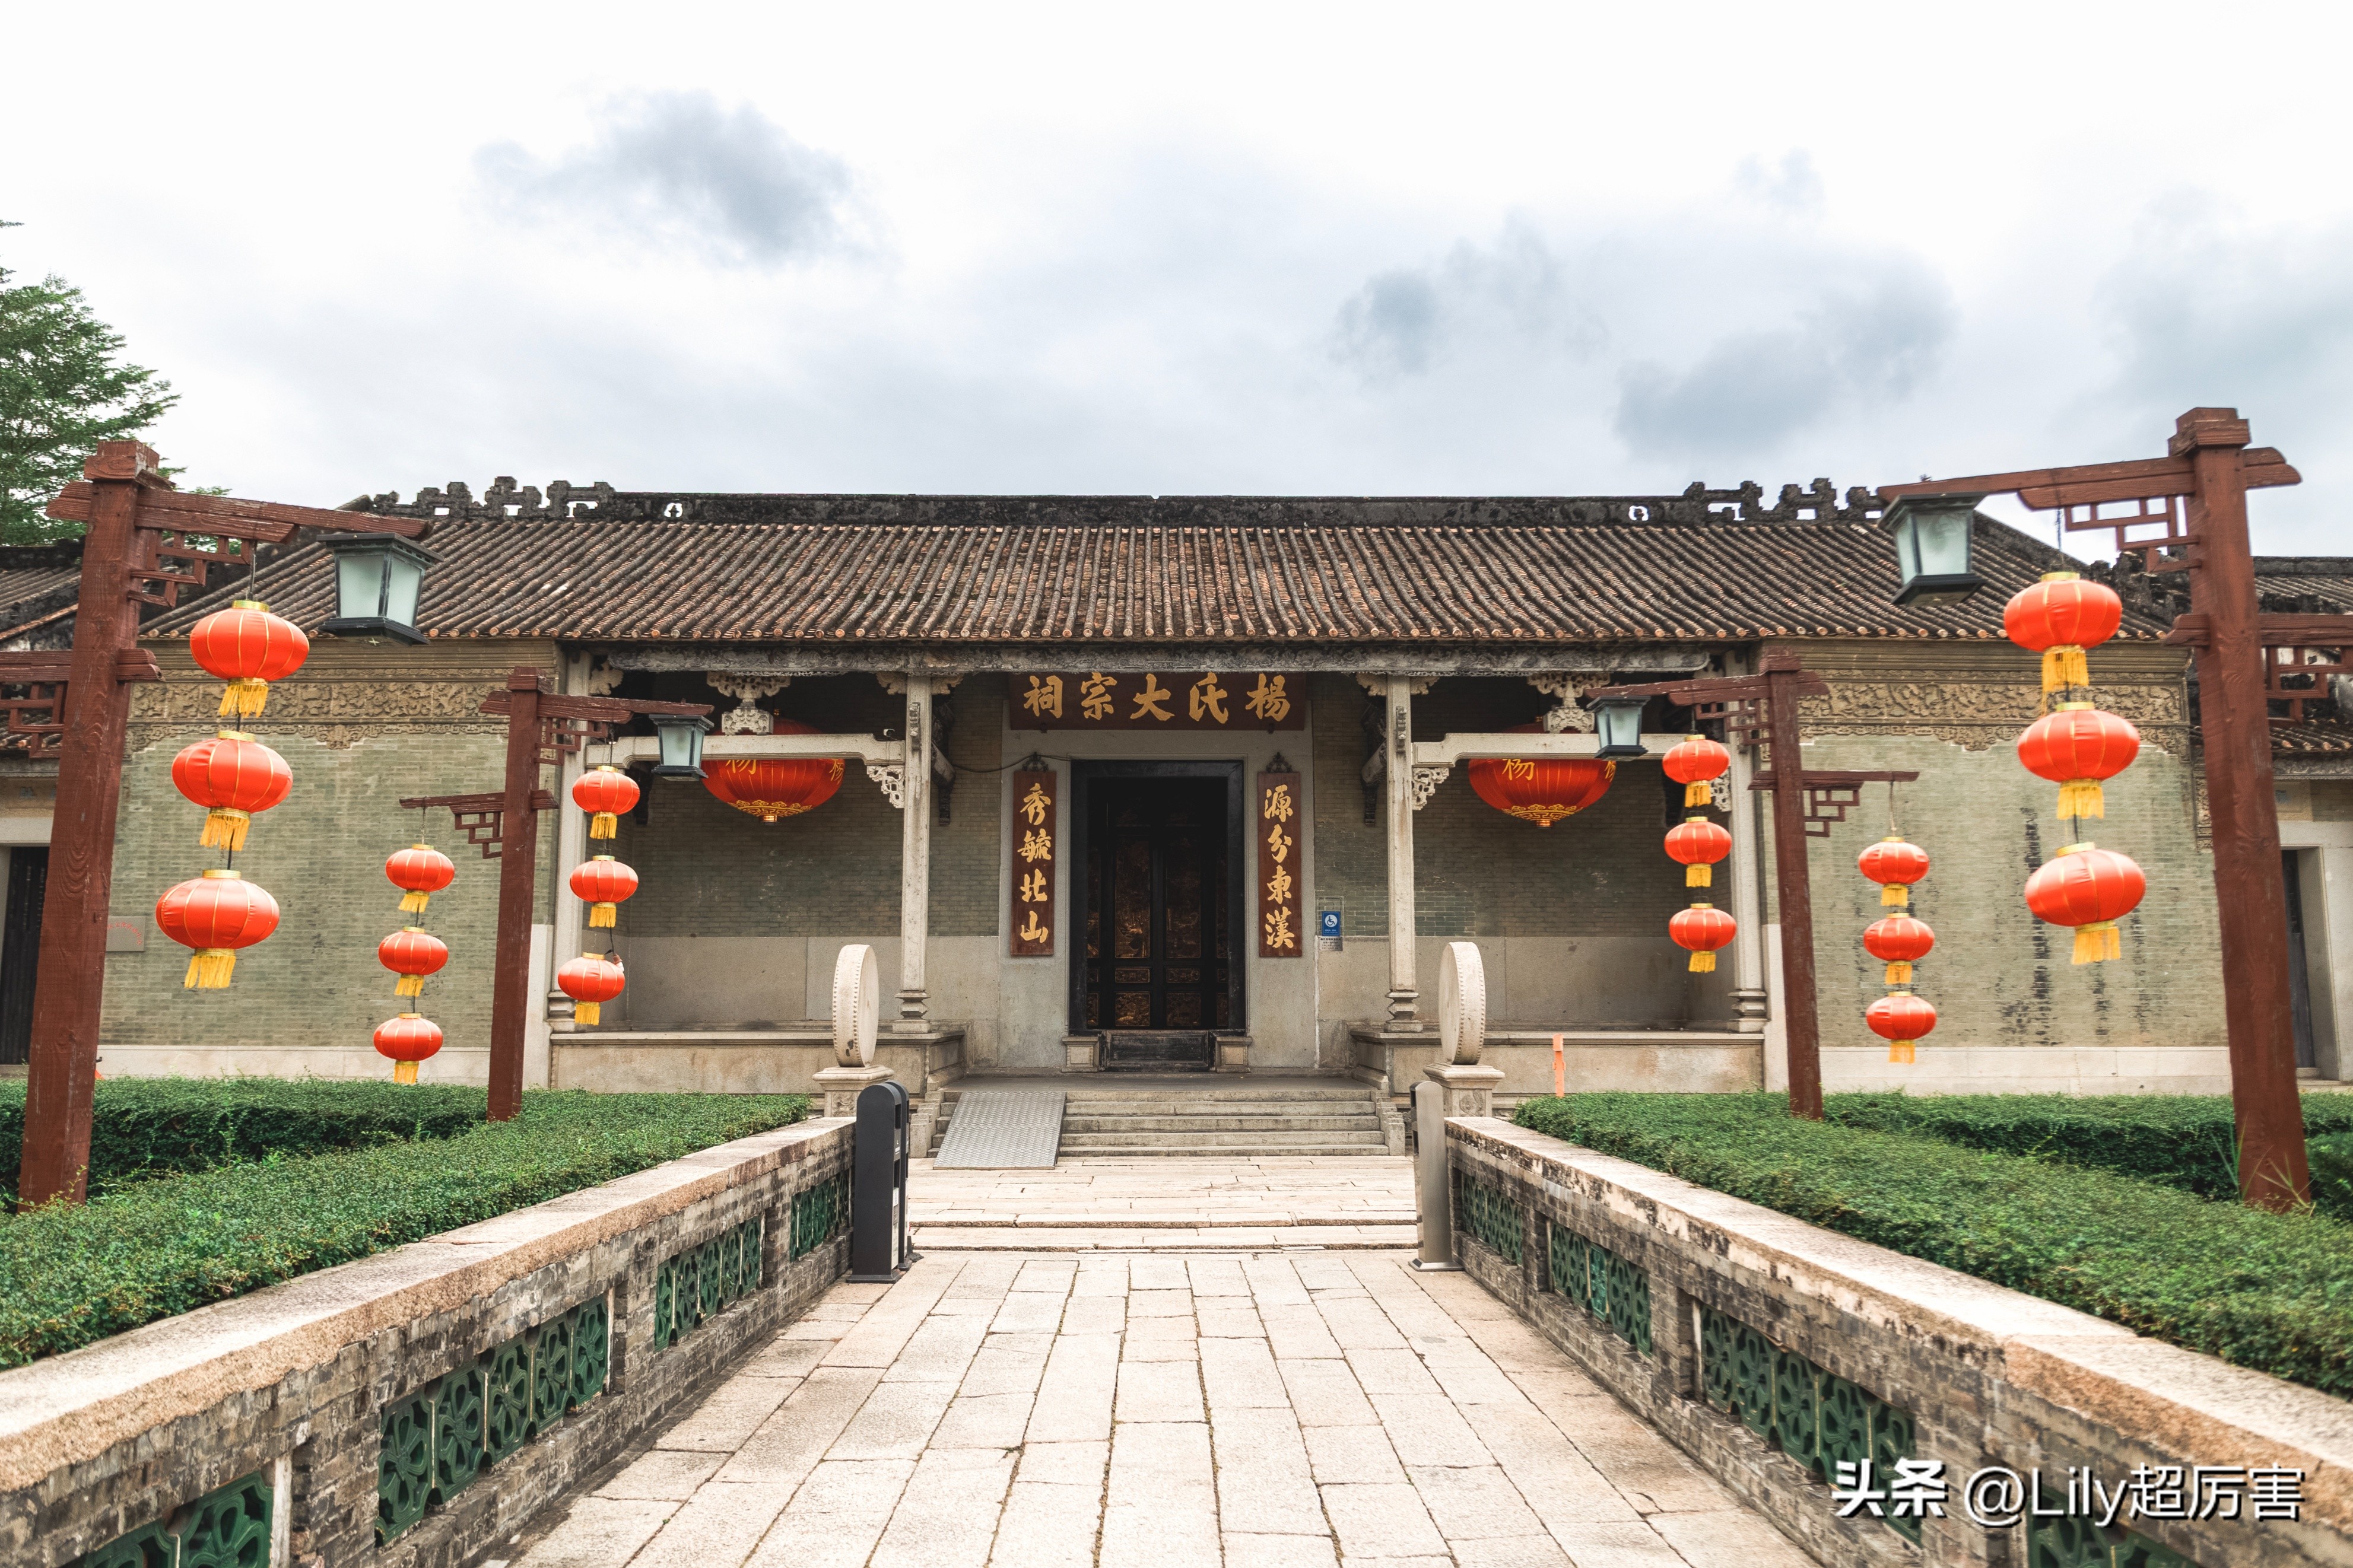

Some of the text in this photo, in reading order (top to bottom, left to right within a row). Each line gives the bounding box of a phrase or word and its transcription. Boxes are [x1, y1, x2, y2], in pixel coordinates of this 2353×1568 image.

[1024, 672, 1290, 724] 楊氏大宗祠
[1017, 783, 1052, 943] 秀毓北山
[1265, 784, 1295, 949] 源分東漢
